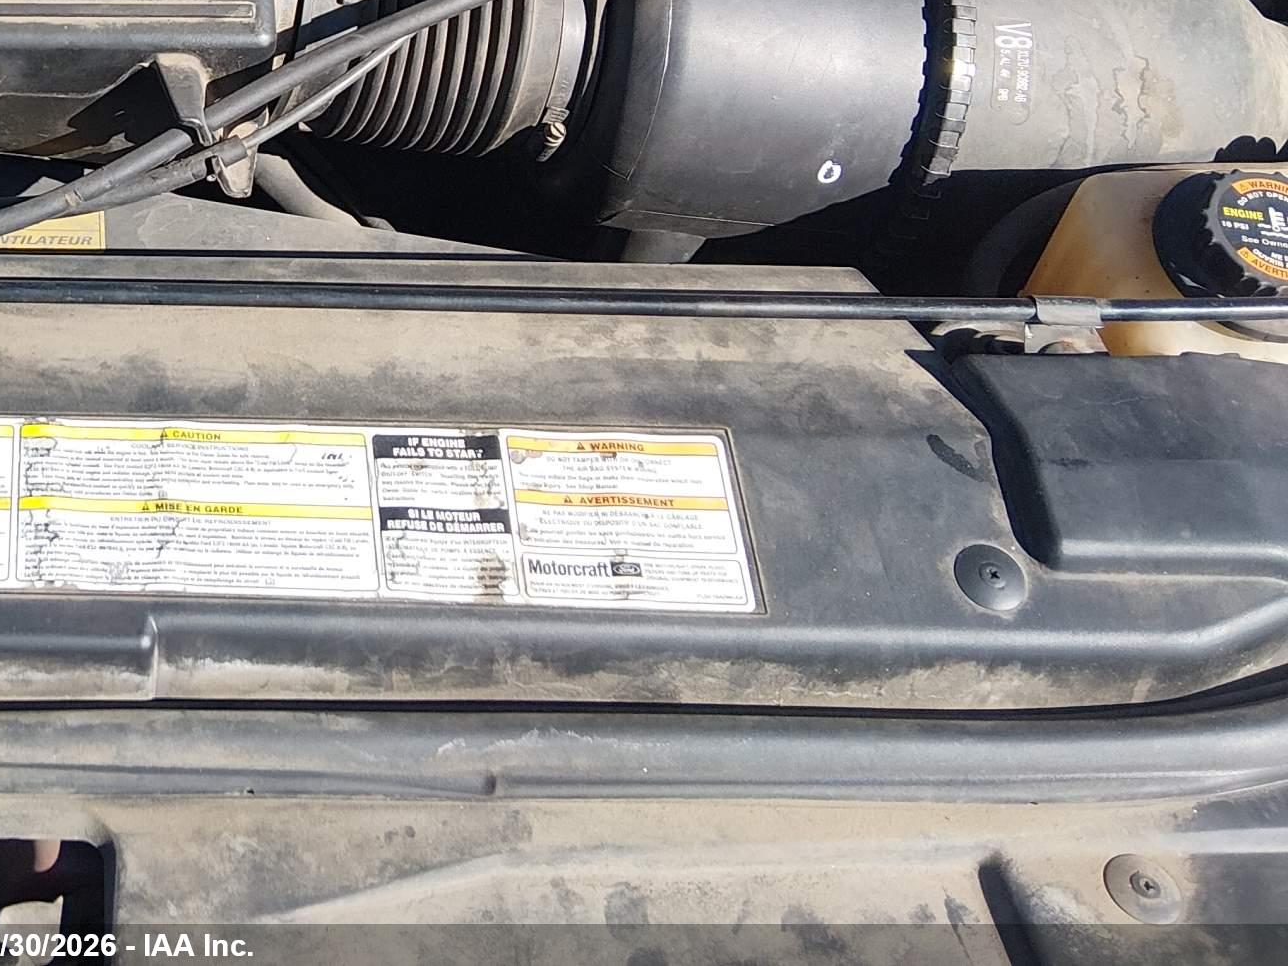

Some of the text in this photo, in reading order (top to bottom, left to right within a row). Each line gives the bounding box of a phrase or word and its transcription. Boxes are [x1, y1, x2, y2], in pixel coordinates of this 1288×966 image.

[994, 22, 1033, 49] V8
[1237, 196, 1249, 206] DO
[1246, 191, 1263, 200] NOT
[1223, 206, 1264, 220] ENGINE
[1233, 222, 1249, 231] PSI
[1241, 235, 1259, 244] See
[172, 431, 221, 440] CAUTION
[408, 437, 466, 448] IF ENGINE
[589, 443, 645, 452] WARNING
[392, 447, 425, 457] FAILS
[427, 448, 444, 457] TO
[579, 495, 676, 507] AVERTISSEMENT
[155, 503, 243, 514] MISE EN GARDE
[408, 509, 481, 521] SI LE MOTEUR
[387, 519, 428, 530] REFUSE
[429, 520, 444, 531] DE
[528, 558, 610, 577] Motorcraft
